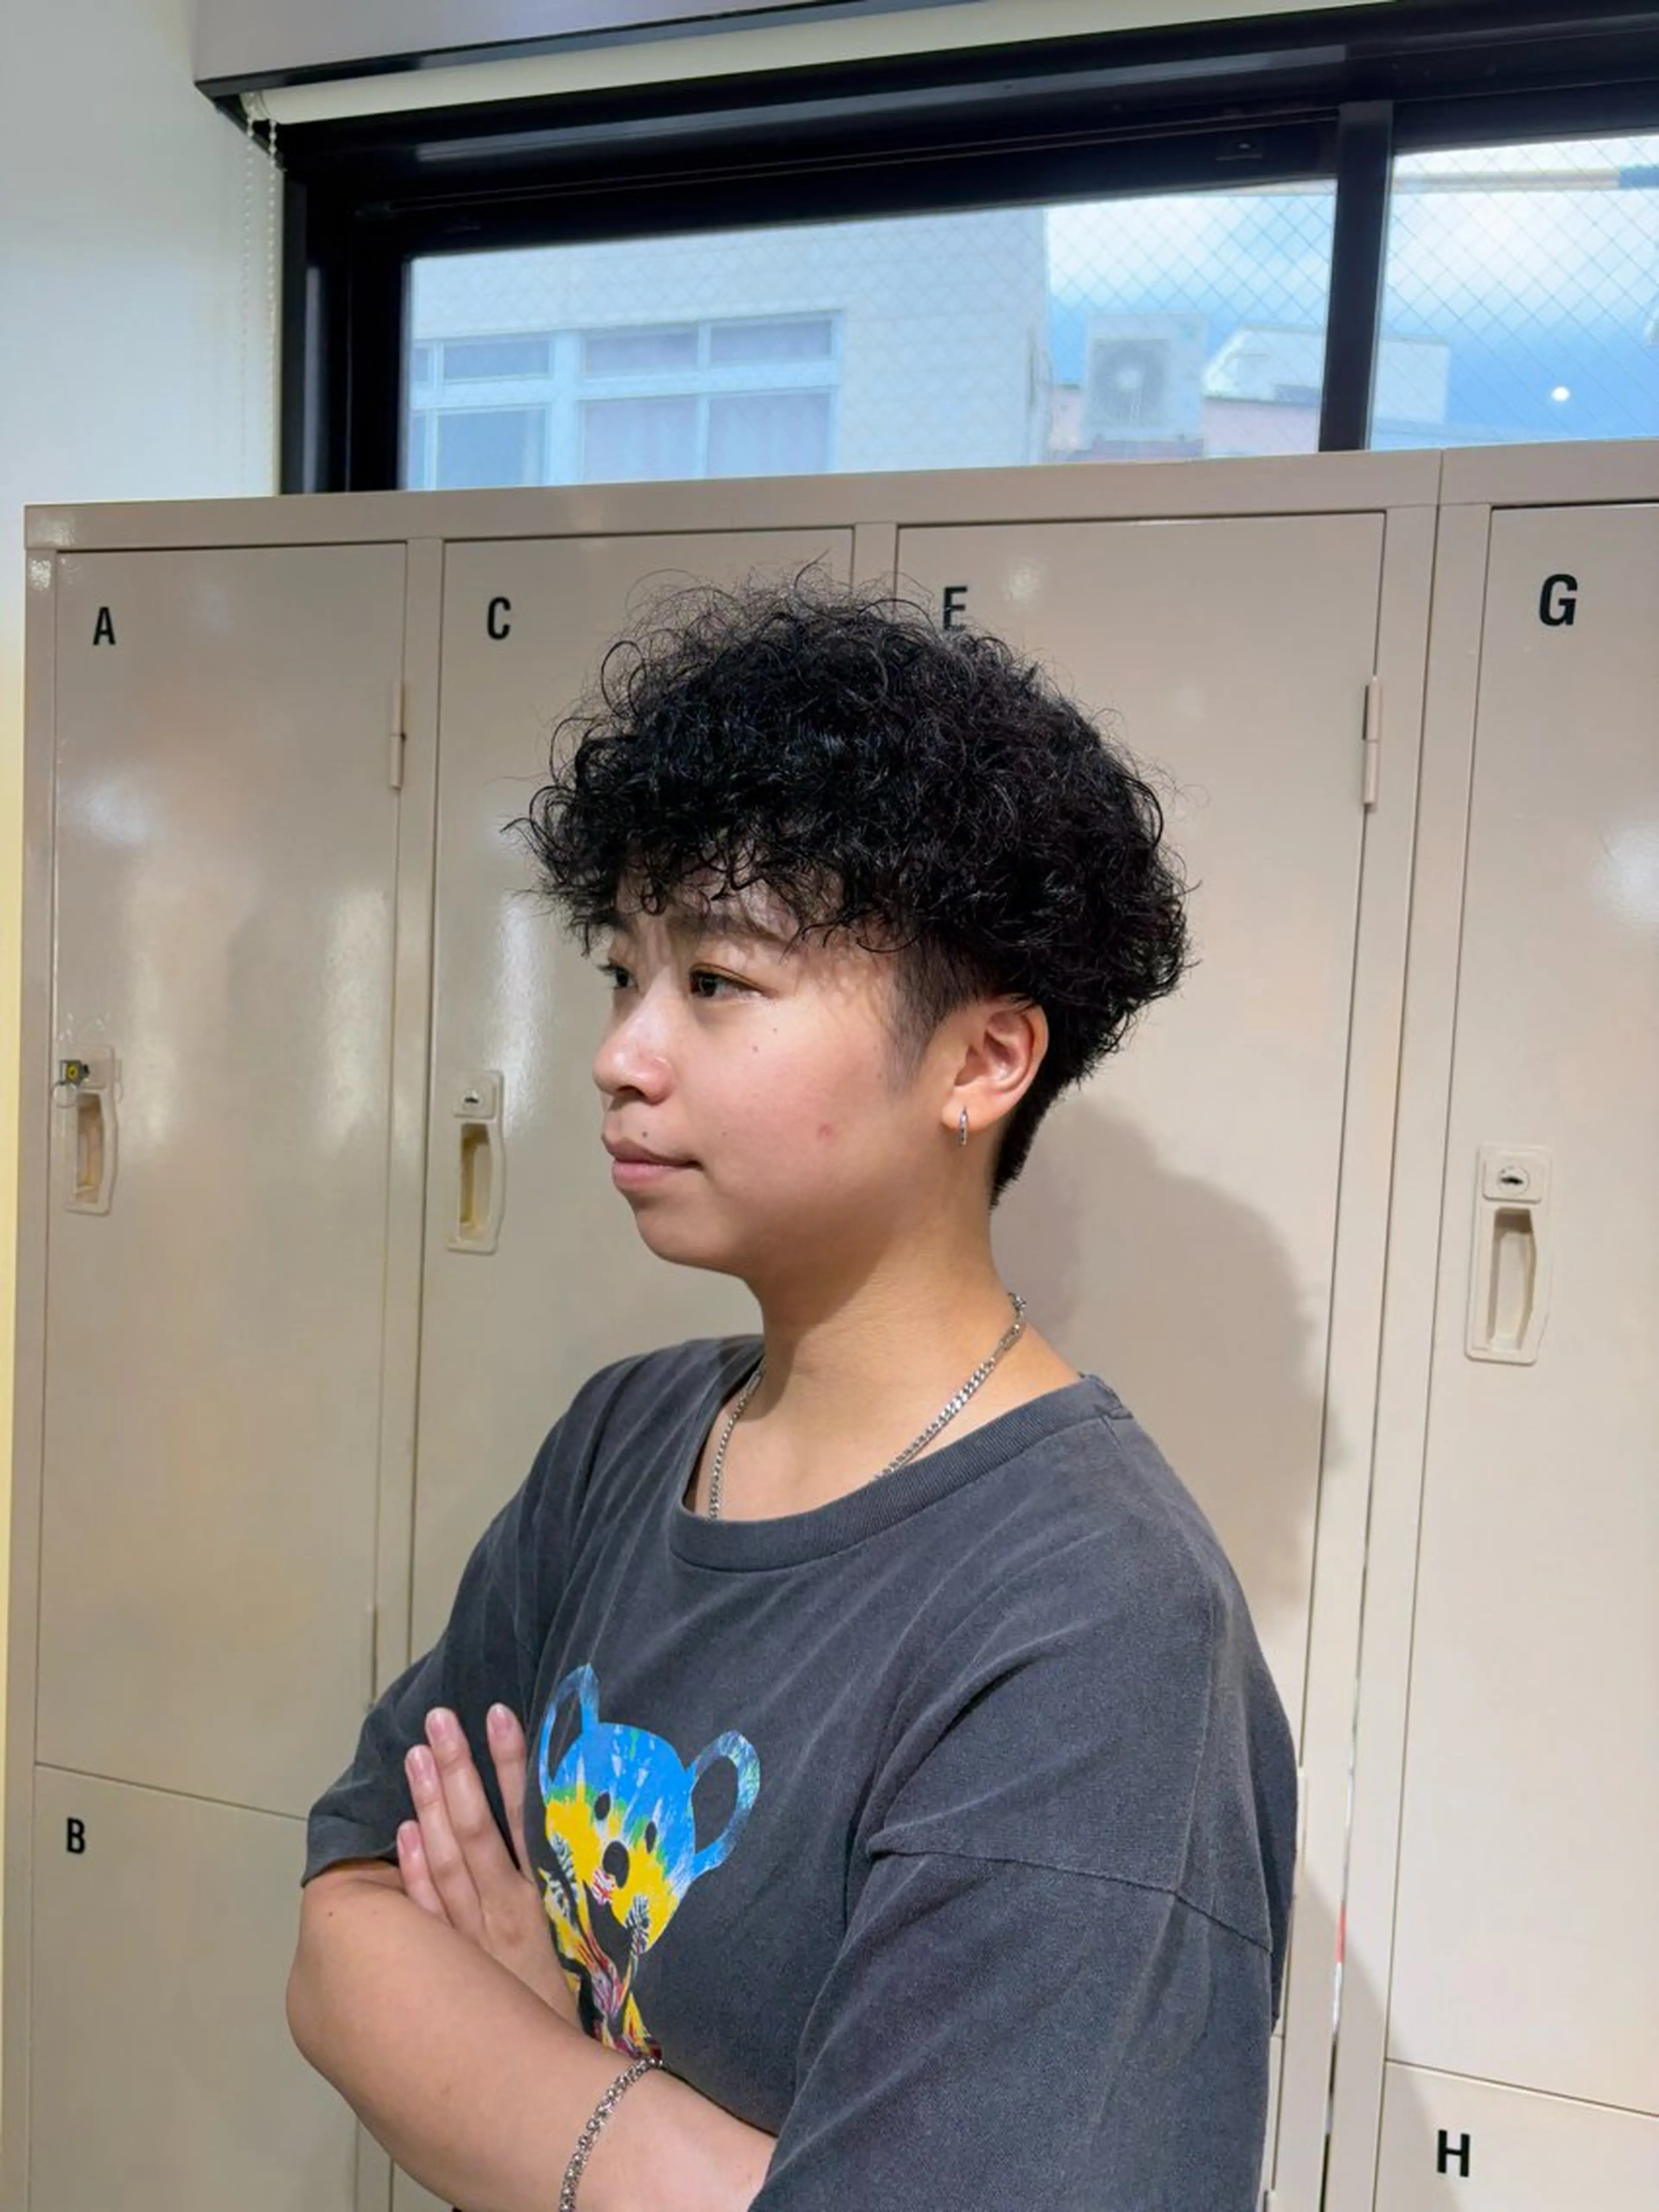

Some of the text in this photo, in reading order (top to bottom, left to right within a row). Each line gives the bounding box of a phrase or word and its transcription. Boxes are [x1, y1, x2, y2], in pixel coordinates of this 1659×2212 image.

[487, 597, 511, 640] C
[1539, 574, 1578, 626] G
[93, 607, 115, 645] A
[67, 1818, 85, 1854] B
[1437, 2129, 1470, 2177] H
